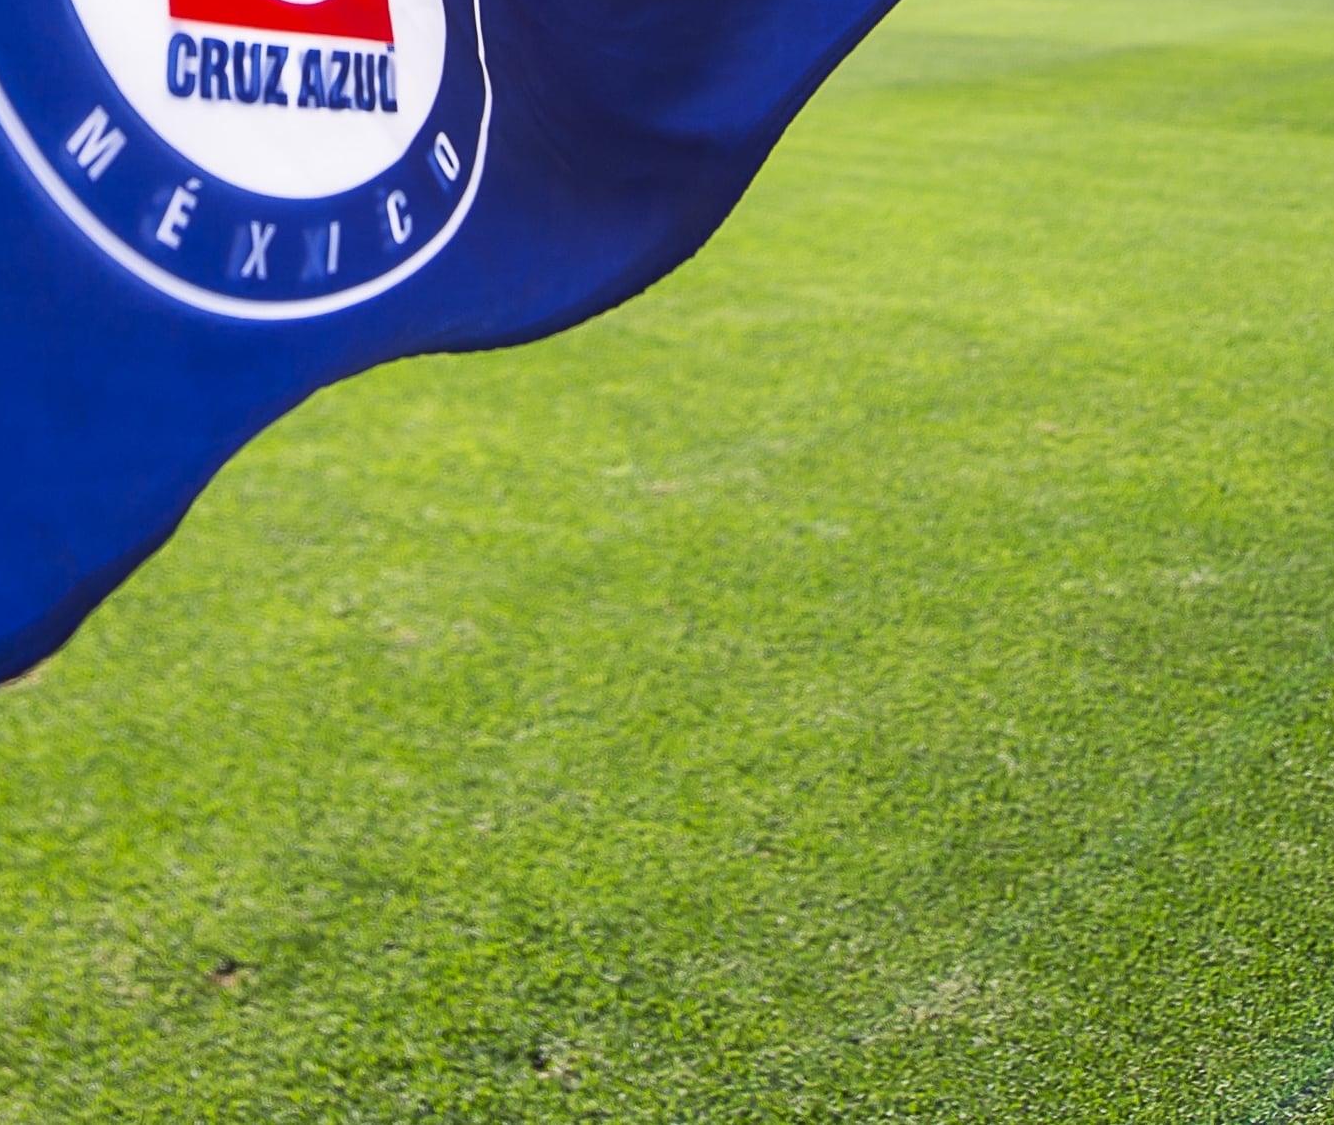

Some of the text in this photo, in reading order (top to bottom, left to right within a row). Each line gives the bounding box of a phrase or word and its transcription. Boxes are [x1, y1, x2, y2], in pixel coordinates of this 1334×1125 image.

[166, 32, 398, 113] CRUZ AZUL
[65, 104, 462, 281] MÉXICO
